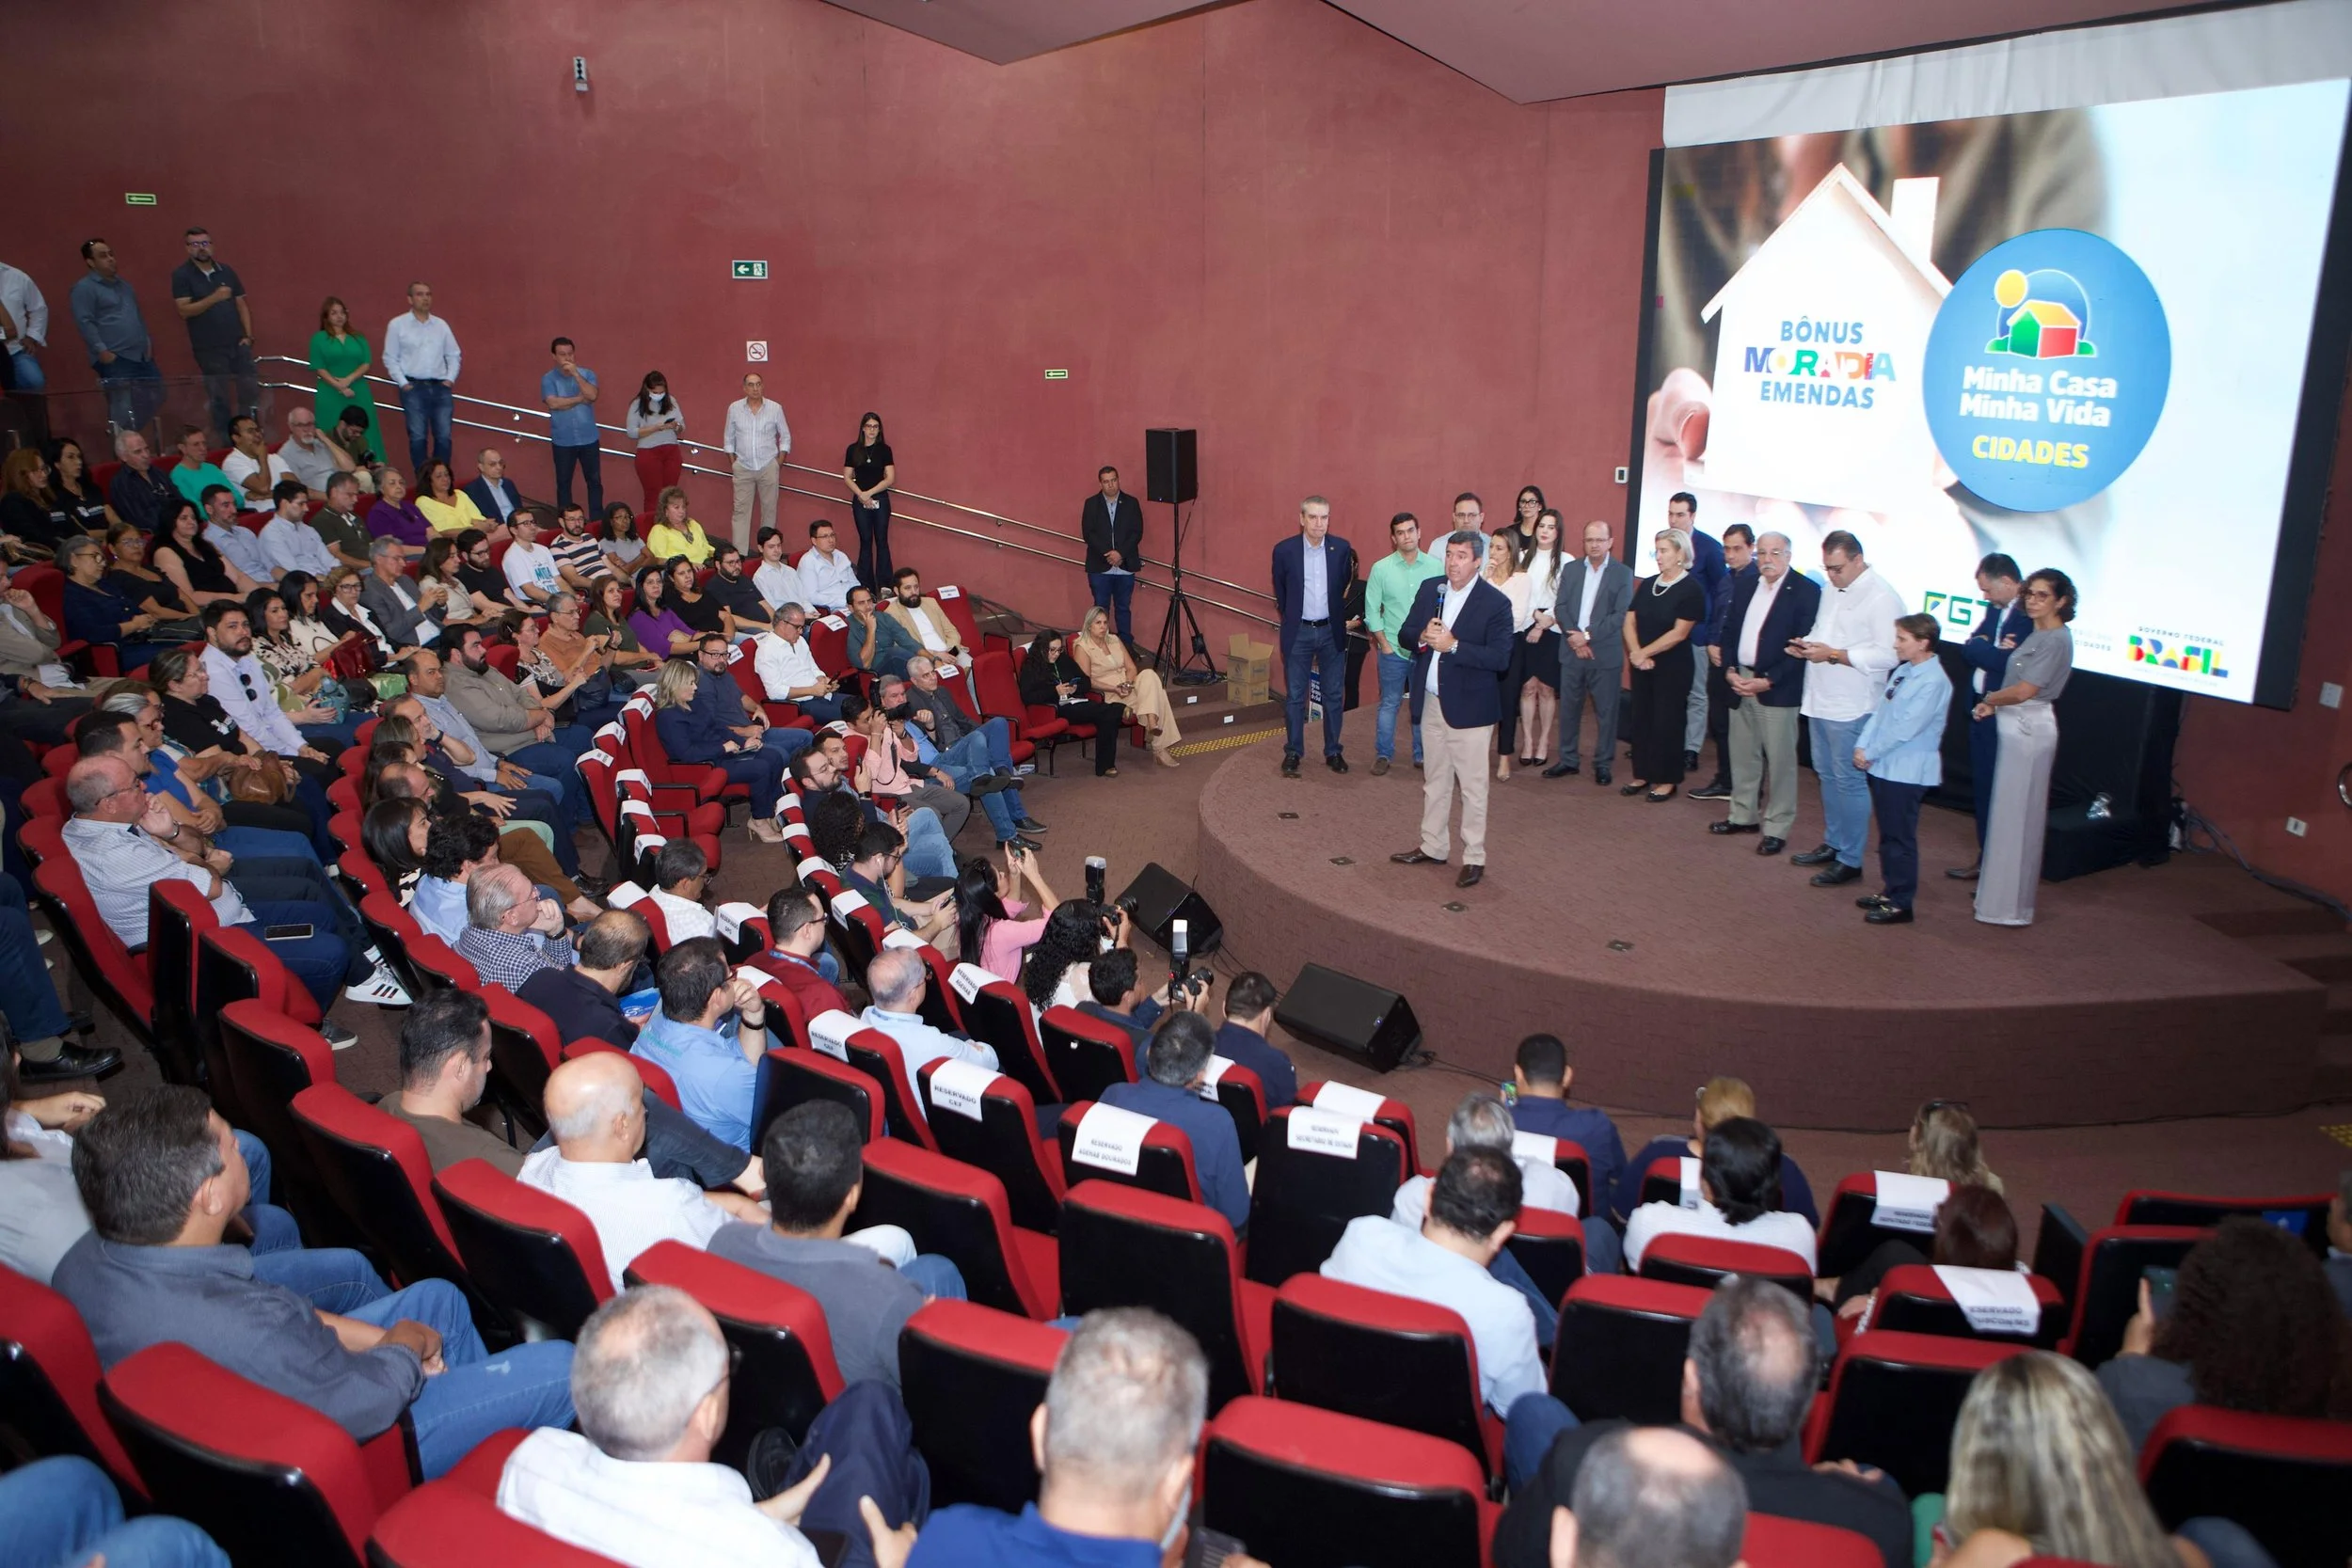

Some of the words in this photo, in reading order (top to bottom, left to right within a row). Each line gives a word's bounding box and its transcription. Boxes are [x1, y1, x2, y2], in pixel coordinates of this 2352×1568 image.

[1780, 315, 1864, 345] BÔNUS
[1760, 380, 1875, 410] EMENDAS
[1963, 365, 2042, 394] Minha
[2049, 370, 2117, 399] Casa
[1959, 392, 2040, 422] Minha
[2046, 398, 2111, 428] Vida
[1972, 435, 2090, 469] CIDADES
[2137, 626, 2180, 639] GOVERNO
[2184, 633, 2225, 647] FEDERAL
[2127, 634, 2229, 678] BRASIL
[957, 968, 978, 991] RESERVADO
[934, 1085, 977, 1104] RESERVADO
[1090, 1138, 1123, 1151] RESERVADO
[1967, 1306, 2024, 1315] ESERVADO
